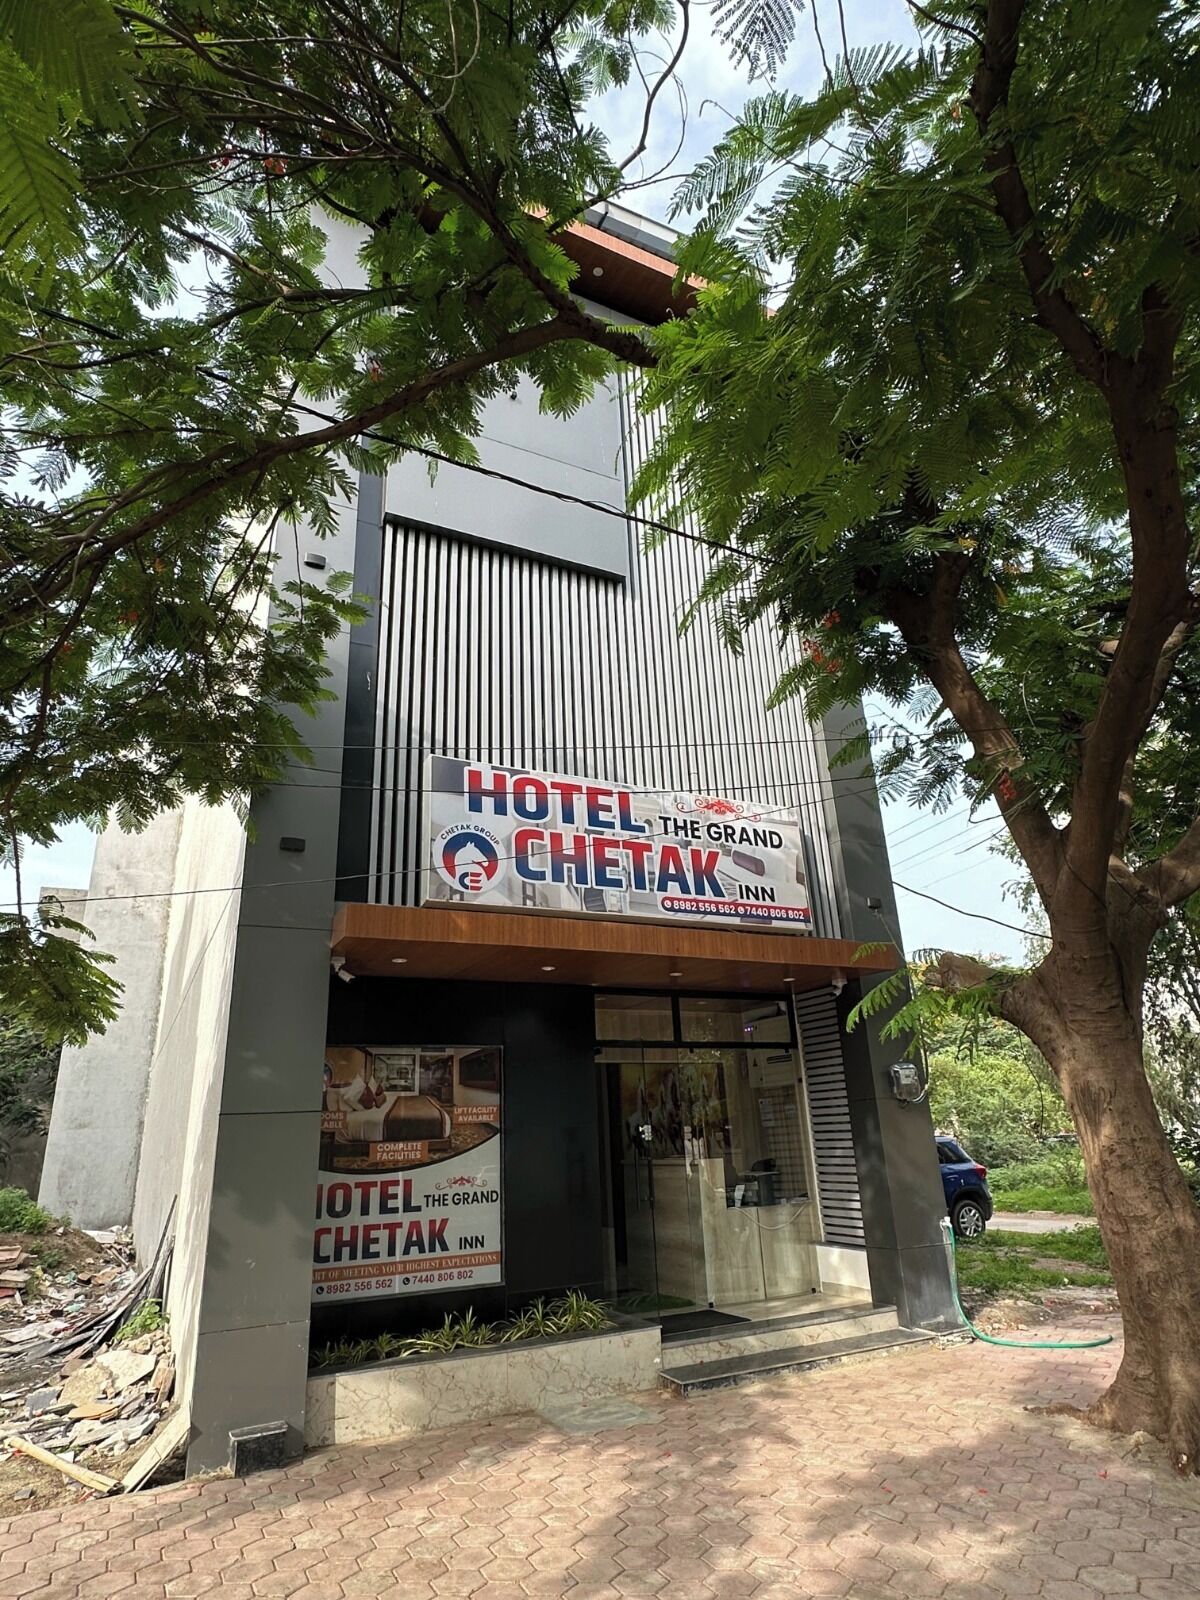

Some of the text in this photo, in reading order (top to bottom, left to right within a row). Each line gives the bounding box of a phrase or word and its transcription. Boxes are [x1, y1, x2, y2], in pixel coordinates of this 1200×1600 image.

[468, 769, 646, 833] HOTEL
[441, 824, 500, 845] CHETAK GROUP
[659, 816, 783, 849] THE GRAND
[514, 828, 725, 898] CHETAK
[738, 884, 776, 902] INN
[673, 901, 804, 919] 8982 556 562 7440 806 802
[458, 1114, 494, 1122] AVAILABLE
[469, 1106, 497, 1114] FACILITY
[377, 1142, 422, 1152] COMPLETE
[377, 1151, 421, 1160] FACILITIES
[424, 1190, 499, 1208] THE GRAND
[313, 1218, 450, 1264] CHETAK
[459, 1235, 485, 1250] INN
[328, 1270, 339, 1279] OF
[343, 1265, 380, 1278] MEETING
[380, 1263, 404, 1274] YOUR
[406, 1259, 440, 1271] HIGHEST
[442, 1254, 497, 1268] EXPECTATIONS
[326, 1270, 474, 1294] 8982 556 562 7440 806 802
